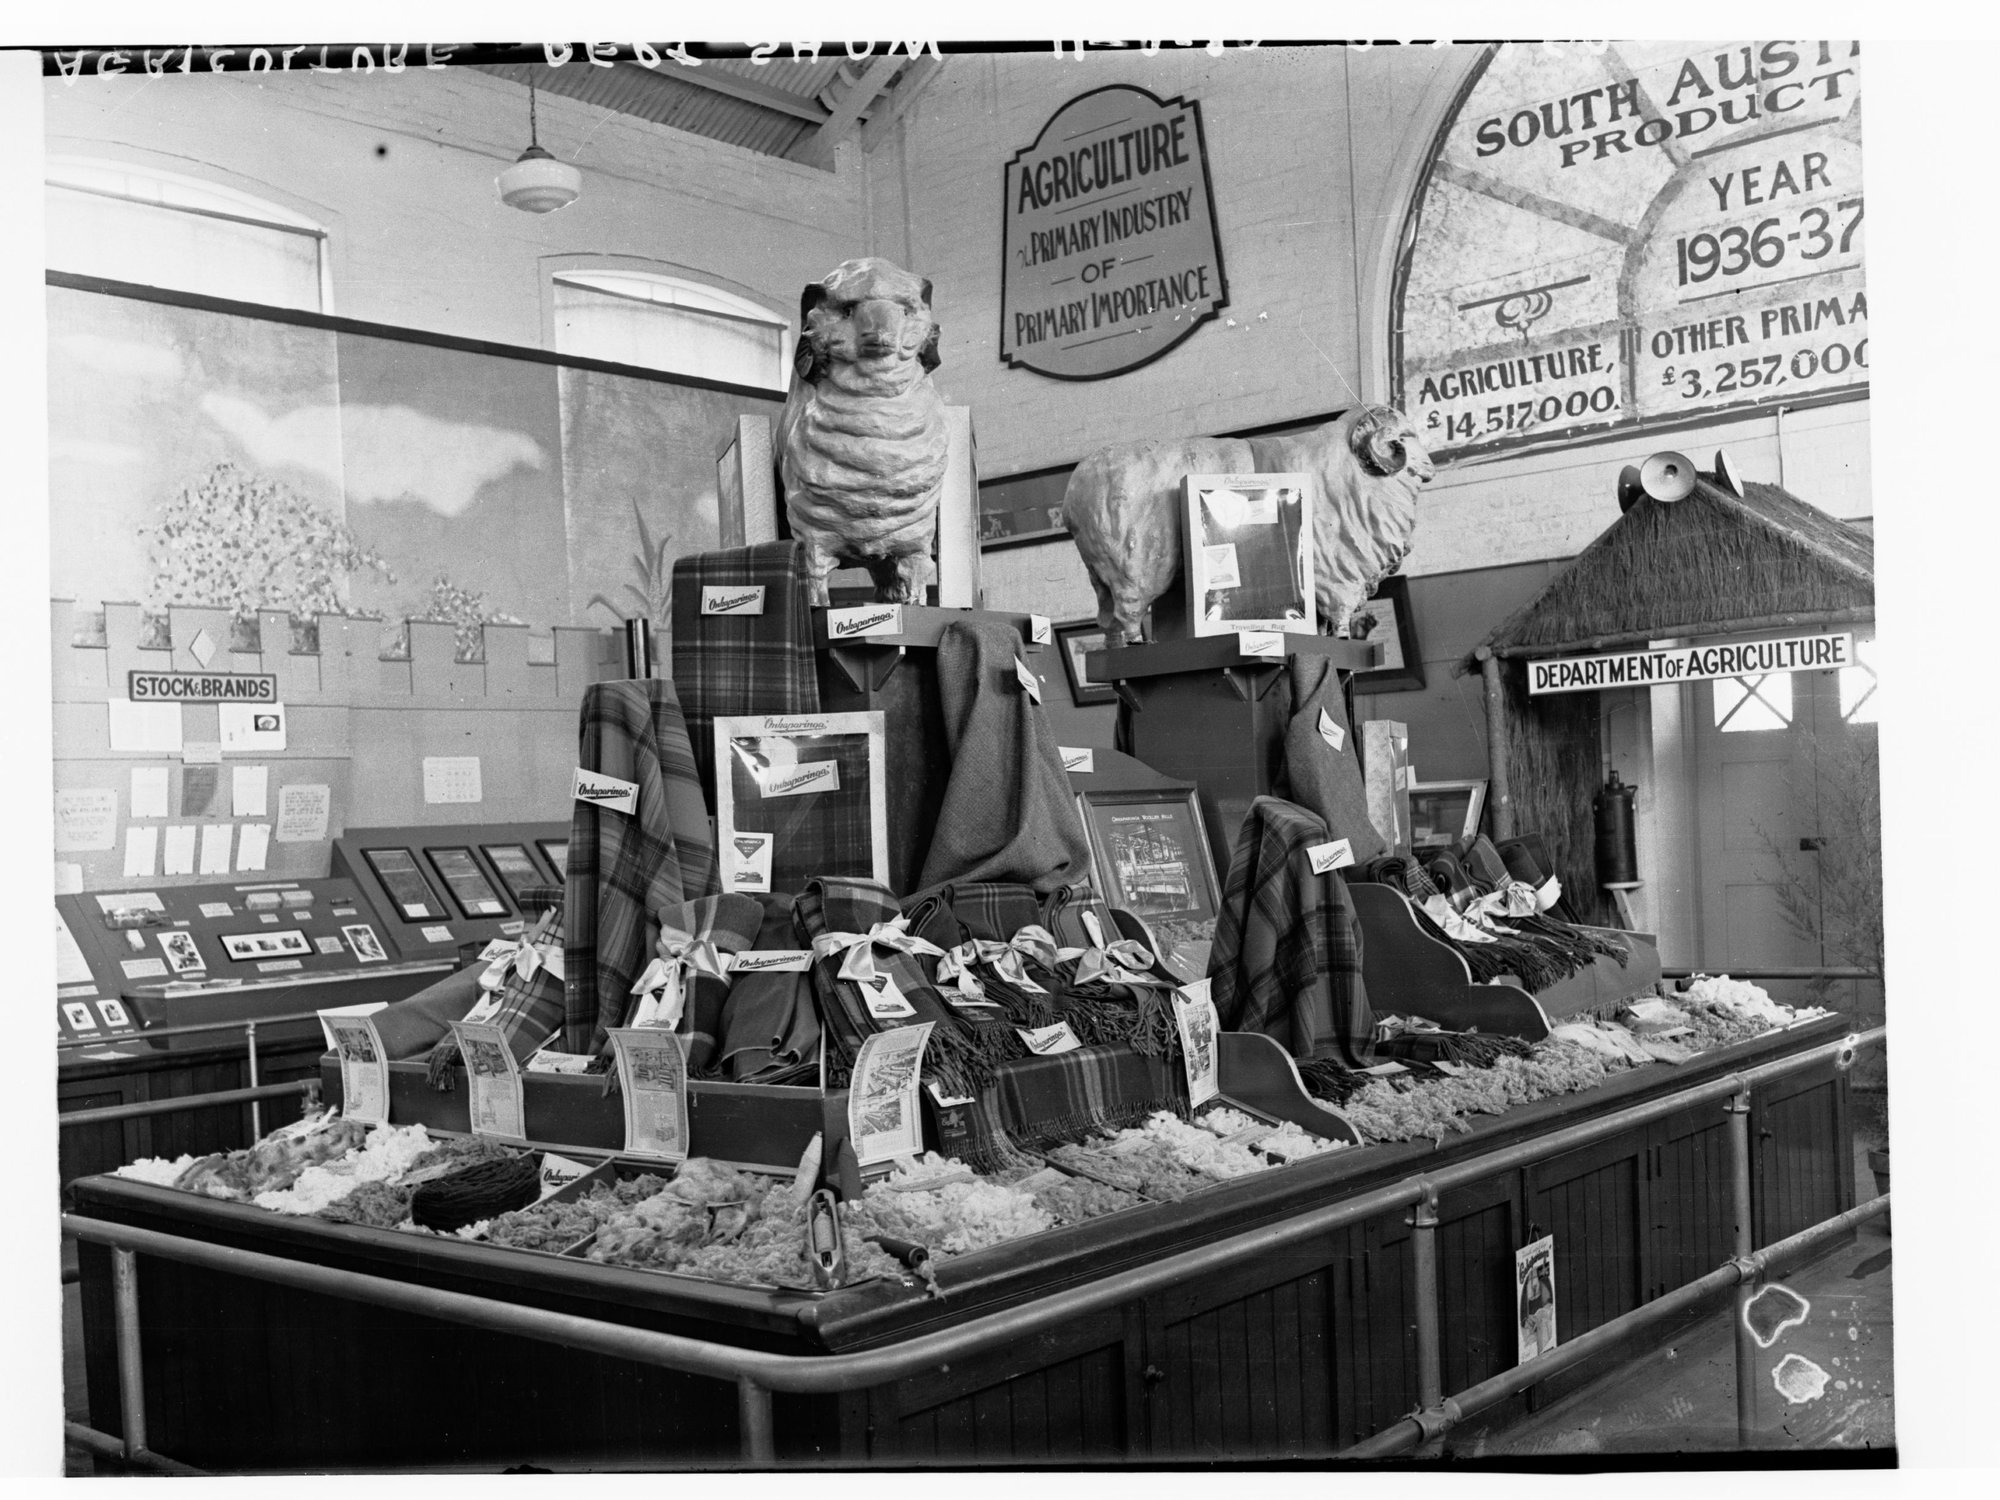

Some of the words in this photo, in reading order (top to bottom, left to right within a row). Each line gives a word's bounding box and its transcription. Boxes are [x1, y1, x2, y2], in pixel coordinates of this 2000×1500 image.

[1476, 78, 1642, 157] SOUTH
[1560, 68, 1854, 168] PRODUCT
[1018, 115, 1189, 214] AGRICULTURE
[1708, 151, 1832, 212] YEAR
[1031, 214, 1101, 266] PRIMARY
[1103, 187, 1192, 244] INDUSTRY
[1676, 197, 1864, 286] 1936-37
[1015, 299, 1089, 347] PRIMARY
[1091, 265, 1210, 328] IMPORTANCE
[1081, 258, 1116, 283] OF
[1651, 315, 1750, 358] OTHER
[1760, 292, 1868, 340] PRIMA
[1419, 344, 1614, 405] AGRICULTURE,
[136, 677, 195, 697] STOCK
[201, 678, 270, 698] BRANDS
[1536, 653, 1666, 689] DEPARTMENT
[1666, 658, 1684, 678] OF
[1686, 636, 1846, 676] AGRICULTURE
